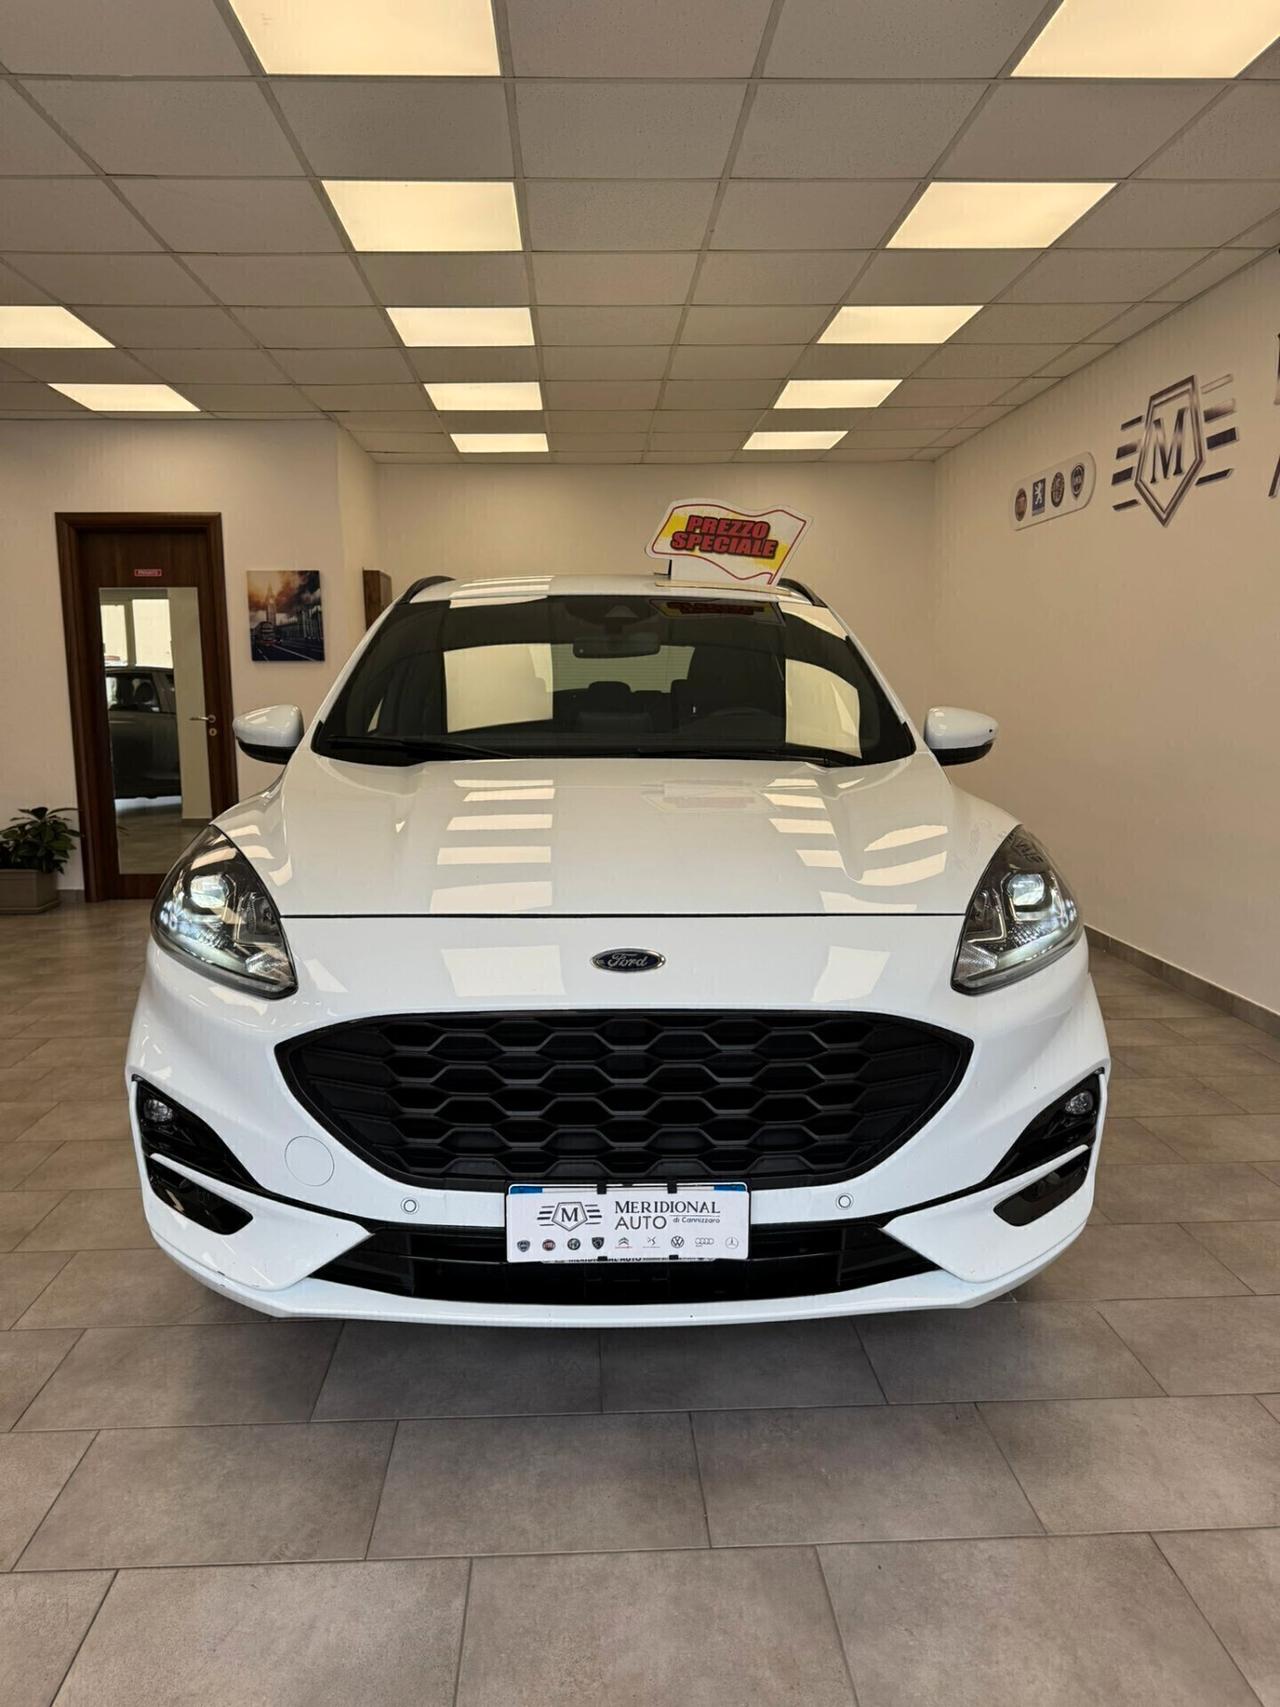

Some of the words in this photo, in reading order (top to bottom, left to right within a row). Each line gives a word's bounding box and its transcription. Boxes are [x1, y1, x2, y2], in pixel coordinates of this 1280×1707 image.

[1150, 407, 1188, 484] M
[686, 515, 770, 539] PREZZO
[670, 531, 778, 559] SPECIALE
[607, 953, 648, 967] Ford
[561, 1207, 579, 1222] M
[615, 1200, 720, 1214] MERIDIONAL
[615, 1215, 667, 1230] AUTO
